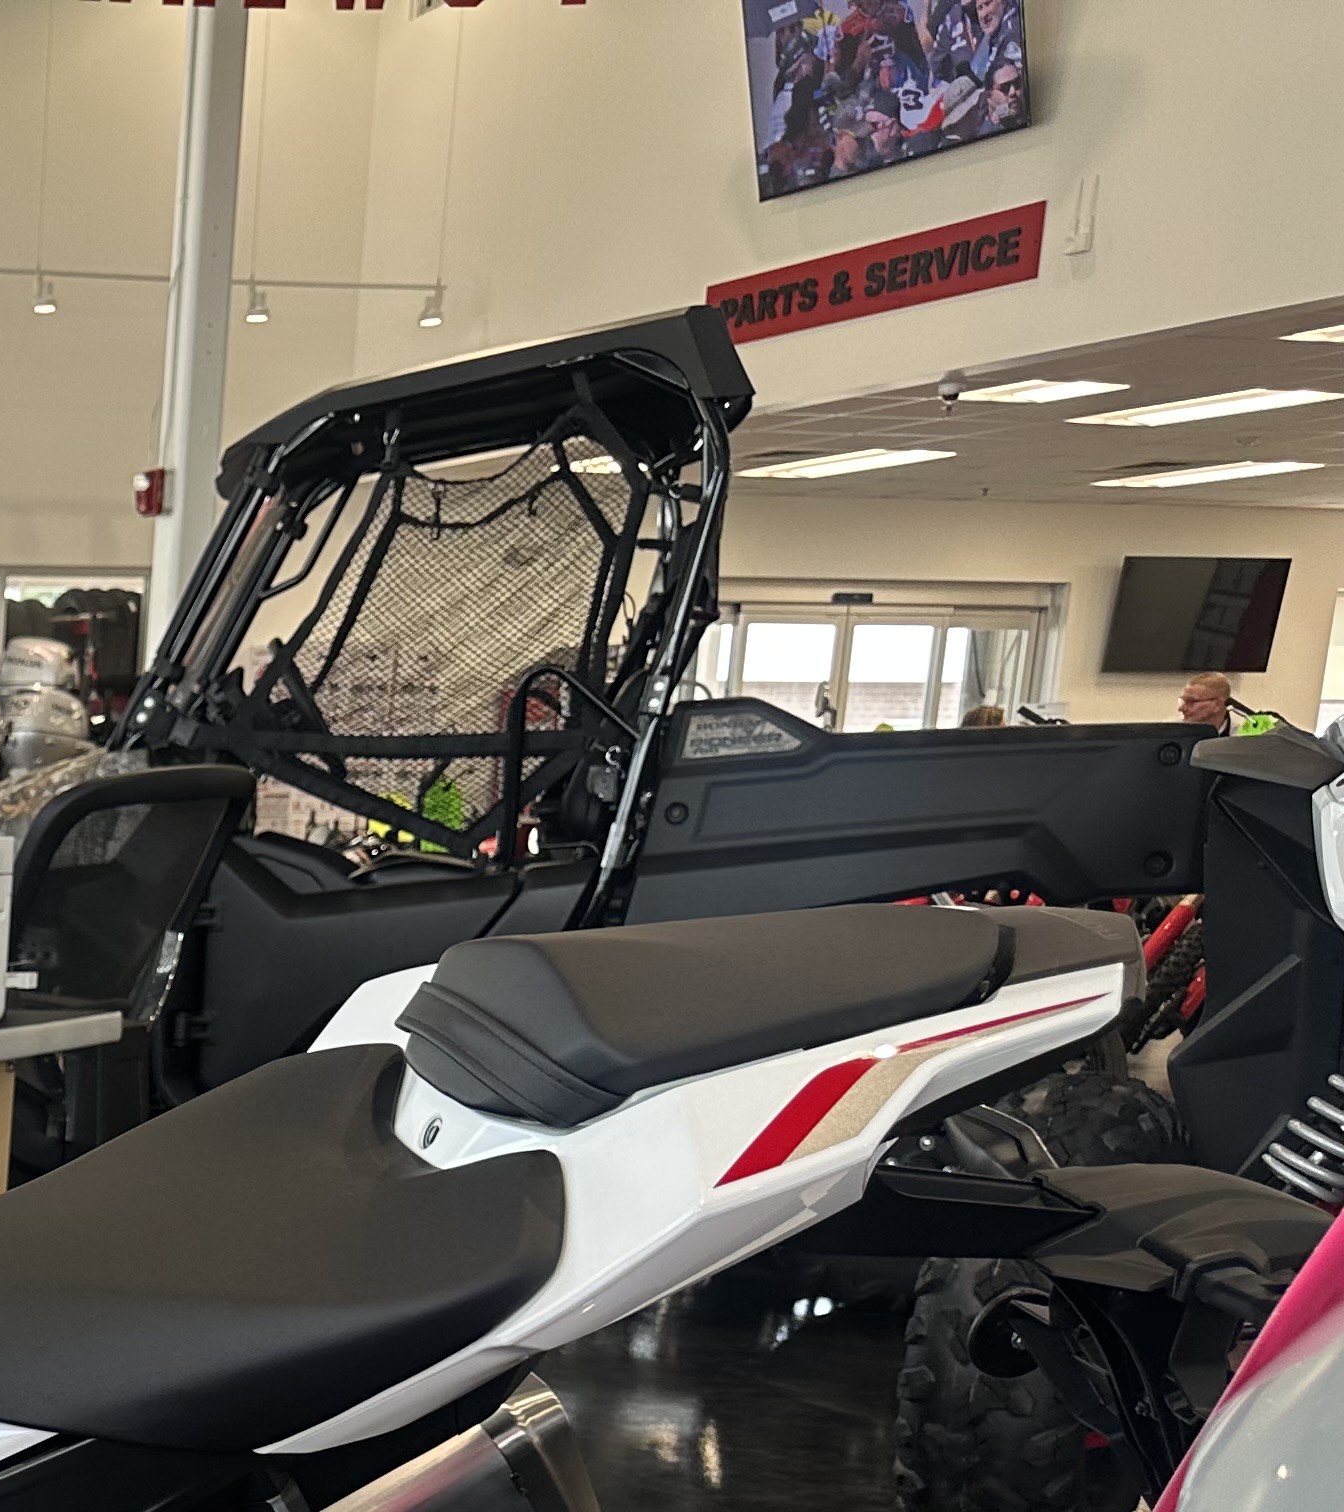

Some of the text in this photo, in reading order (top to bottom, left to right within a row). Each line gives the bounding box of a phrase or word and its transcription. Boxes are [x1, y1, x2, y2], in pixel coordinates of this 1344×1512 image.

[723, 226, 1023, 328] PARTS & SERVICE
